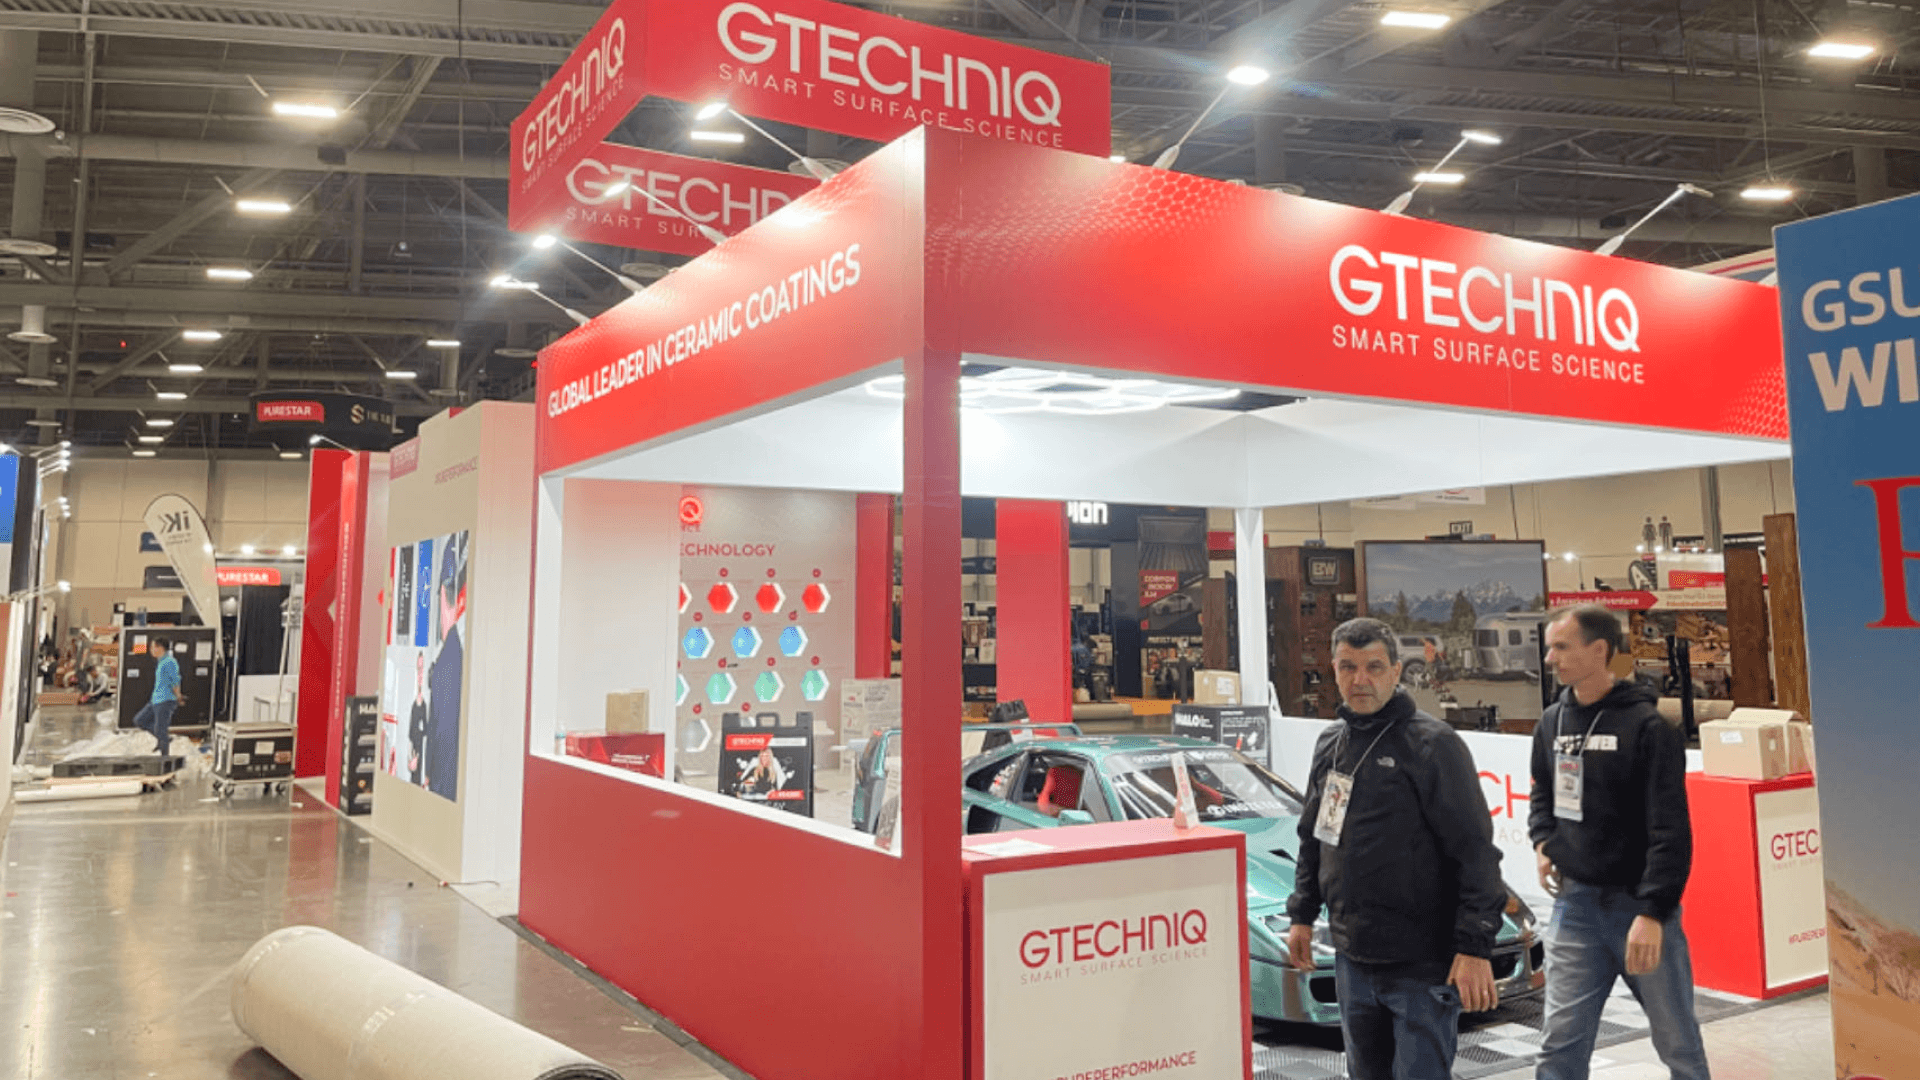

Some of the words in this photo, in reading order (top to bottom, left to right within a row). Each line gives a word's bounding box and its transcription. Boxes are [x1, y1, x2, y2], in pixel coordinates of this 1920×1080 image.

[522, 17, 626, 171] GTECHNIQ
[717, 2, 1062, 128] GTECHNIQ
[719, 63, 816, 98] SMART
[834, 89, 949, 128] SURFACE
[964, 117, 1063, 148] SCIENCE
[566, 206, 644, 229] SMART
[547, 375, 593, 418] GLOBAL
[592, 348, 645, 400] LEADER
[646, 339, 663, 375] IN
[664, 301, 742, 366] CERAMIC
[745, 243, 861, 331] COATINGS
[1329, 243, 1641, 353] GTECHNIQ
[1332, 324, 1420, 356] SMART
[1433, 336, 1541, 372] SURFACE
[1551, 352, 1645, 384] SCIENCE
[1771, 829, 1819, 860] GTEC
[1019, 908, 1208, 969] GTECHNIQ
[1020, 966, 1071, 985] SMART
[1080, 956, 1143, 976] SURFACE
[1151, 947, 1208, 964] SCIENCE
